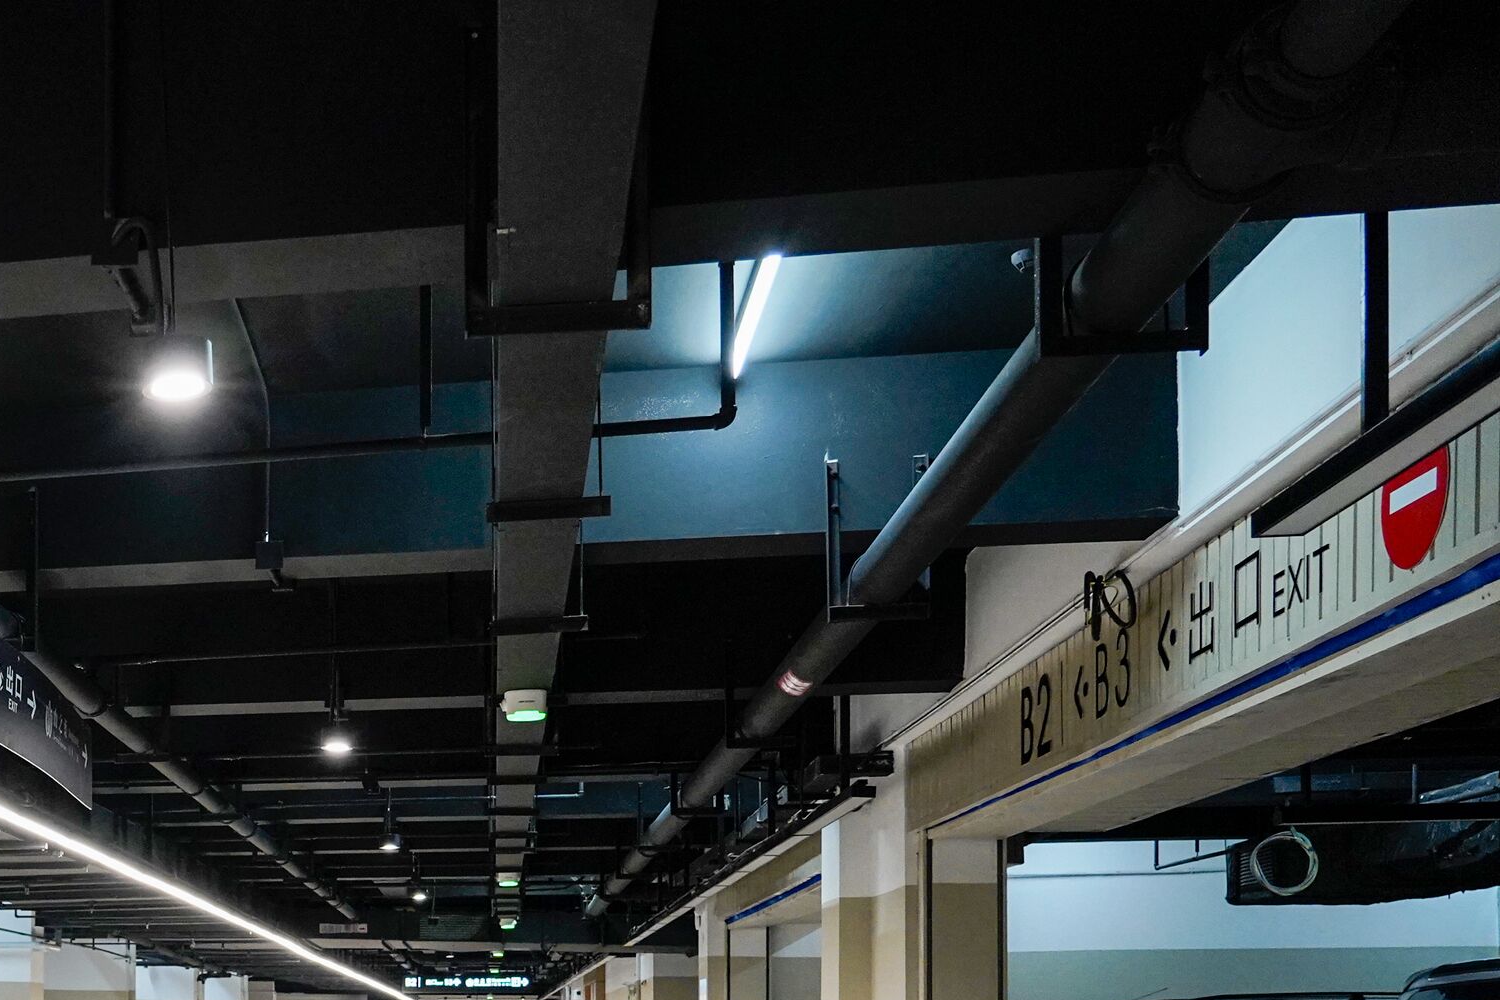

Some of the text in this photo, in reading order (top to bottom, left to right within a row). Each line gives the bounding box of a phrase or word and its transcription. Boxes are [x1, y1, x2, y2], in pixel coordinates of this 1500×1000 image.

[1020, 543, 1330, 765] B2 B3 出口 EXIT
[5, 665, 23, 702] 出口
[8, 697, 19, 714] EXIT
